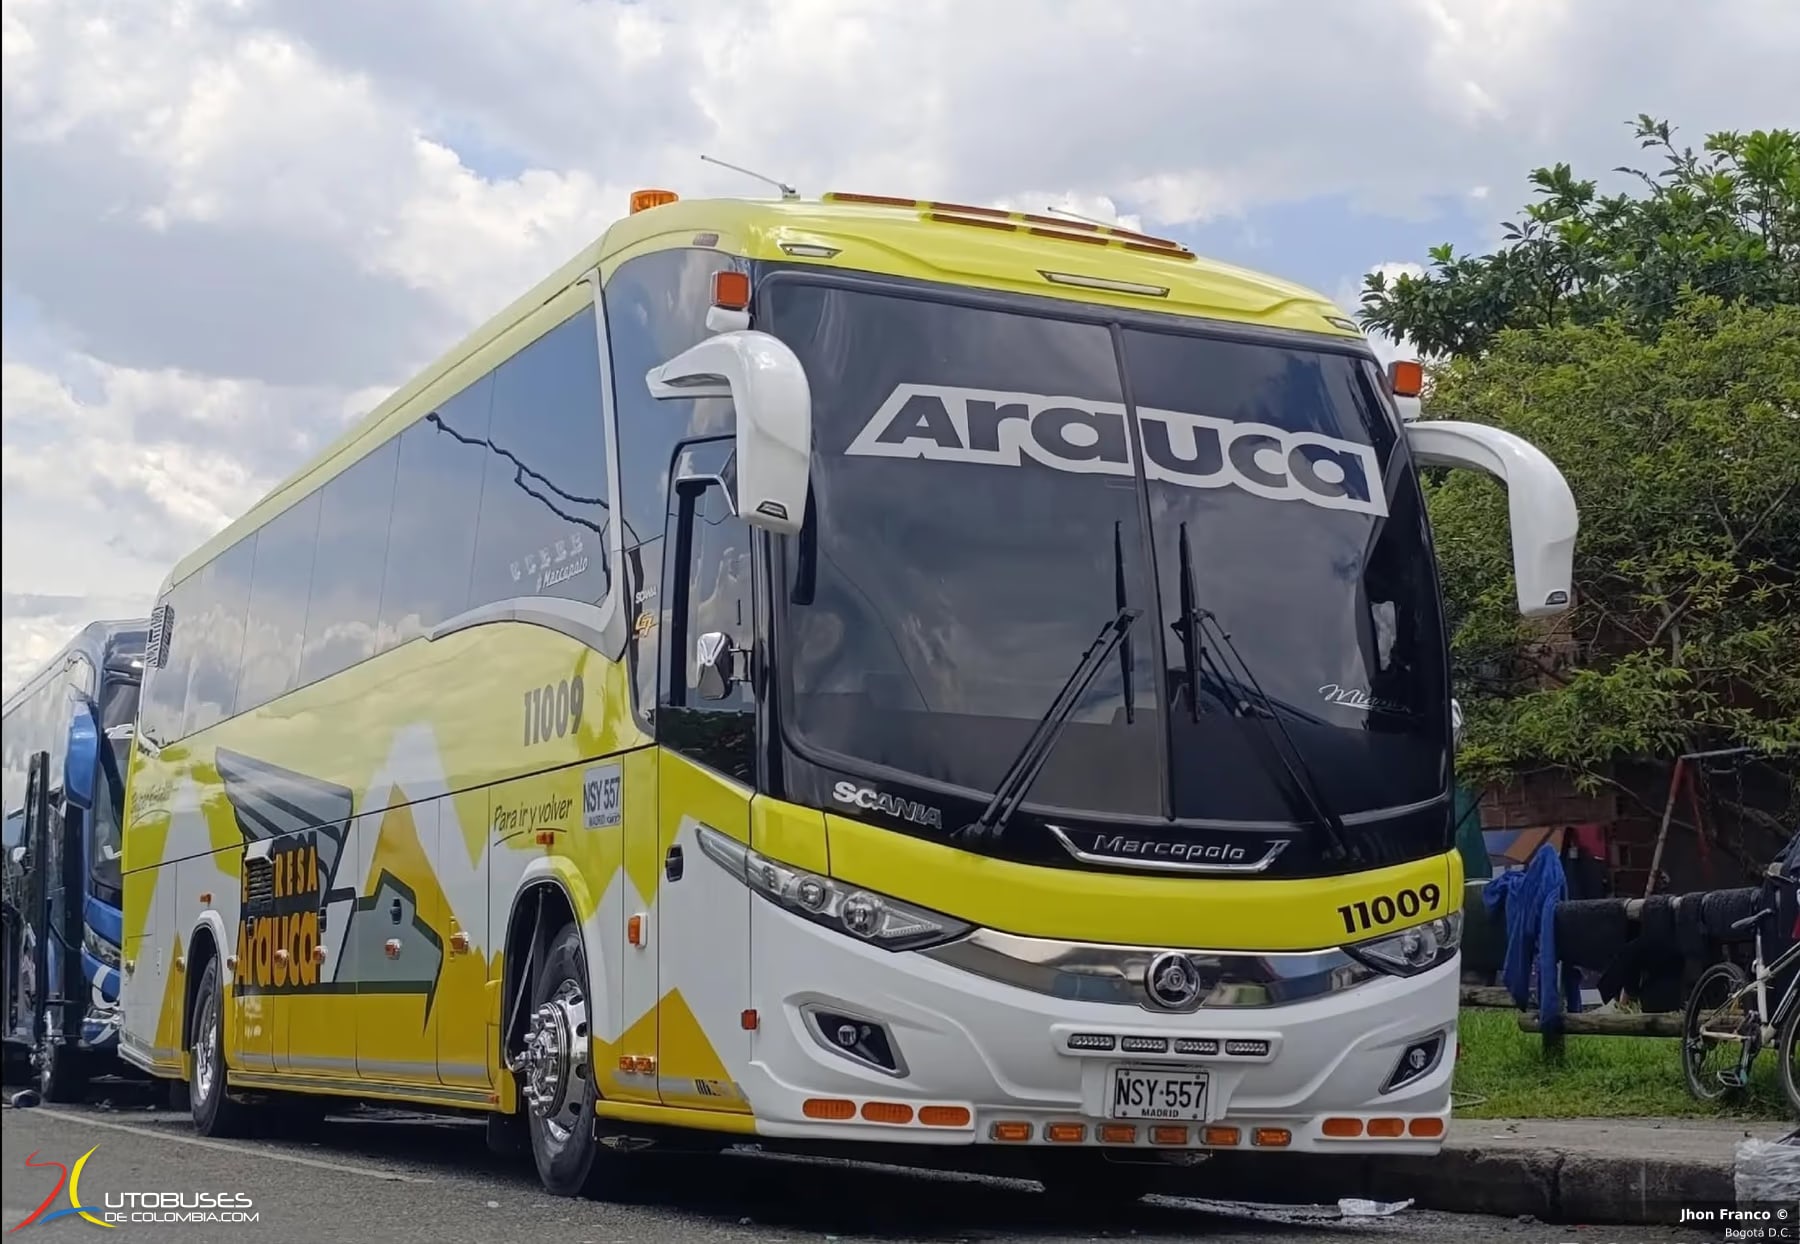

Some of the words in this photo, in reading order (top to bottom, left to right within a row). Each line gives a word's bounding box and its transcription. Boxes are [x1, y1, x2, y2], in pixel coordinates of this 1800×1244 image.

[874, 393, 1372, 503] Arauca
[524, 675, 584, 747] 11009
[494, 805, 518, 832] Para
[519, 801, 528, 828] ir
[528, 805, 537, 834] y
[539, 793, 573, 823] volver
[583, 780, 603, 813] NSY
[604, 776, 620, 810] 557
[832, 781, 942, 829] SCANIA
[1093, 834, 1246, 860] Marcopolo
[1337, 883, 1441, 934] 11009
[235, 911, 318, 988] Arauca
[1142, 1108, 1179, 1118] MADRID
